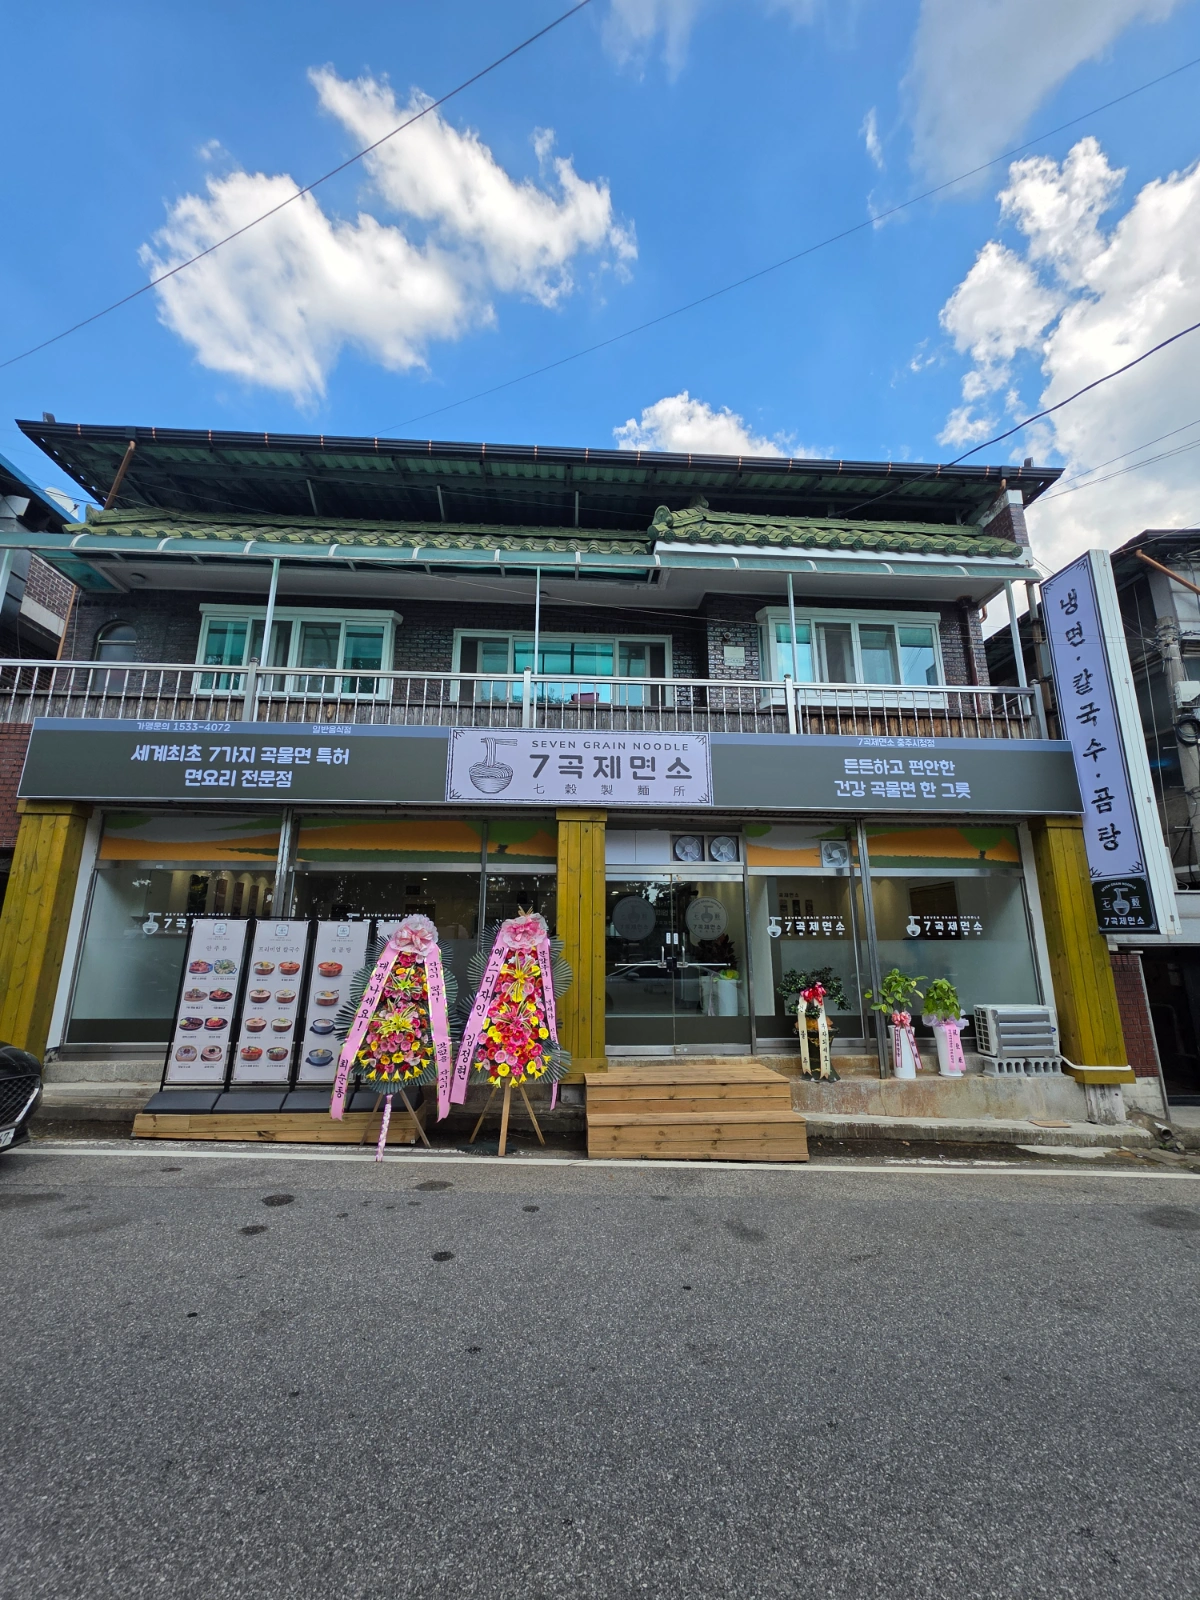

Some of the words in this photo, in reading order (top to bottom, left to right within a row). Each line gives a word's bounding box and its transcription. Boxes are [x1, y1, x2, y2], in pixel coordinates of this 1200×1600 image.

[137, 722, 170, 732] 가맹문의
[173, 723, 231, 732] 1533-4072
[312, 725, 352, 735] 일반음식점
[532, 740, 576, 749] SEVEN
[583, 741, 626, 750] GRAIN
[633, 742, 689, 751] NOODLE
[858, 737, 895, 747] 7곡제면소
[131, 744, 202, 763] 세계최초
[208, 746, 256, 764] 7가지
[261, 746, 312, 765] 곡물면
[315, 748, 350, 766] 특허
[529, 754, 693, 781] 7곡제면소
[844, 758, 905, 775] 든든하고
[908, 760, 955, 776] 편안한
[184, 769, 236, 787] 면요리
[241, 769, 293, 788] 전문점
[833, 780, 866, 798] 건강
[870, 781, 916, 798] 곡물면
[920, 781, 936, 798] 한
[941, 782, 972, 799] 그릇
[784, 921, 846, 931] 7곡제면소
[923, 921, 983, 931] 7곡제면소
[476, 947, 504, 1017] 에스디자인
